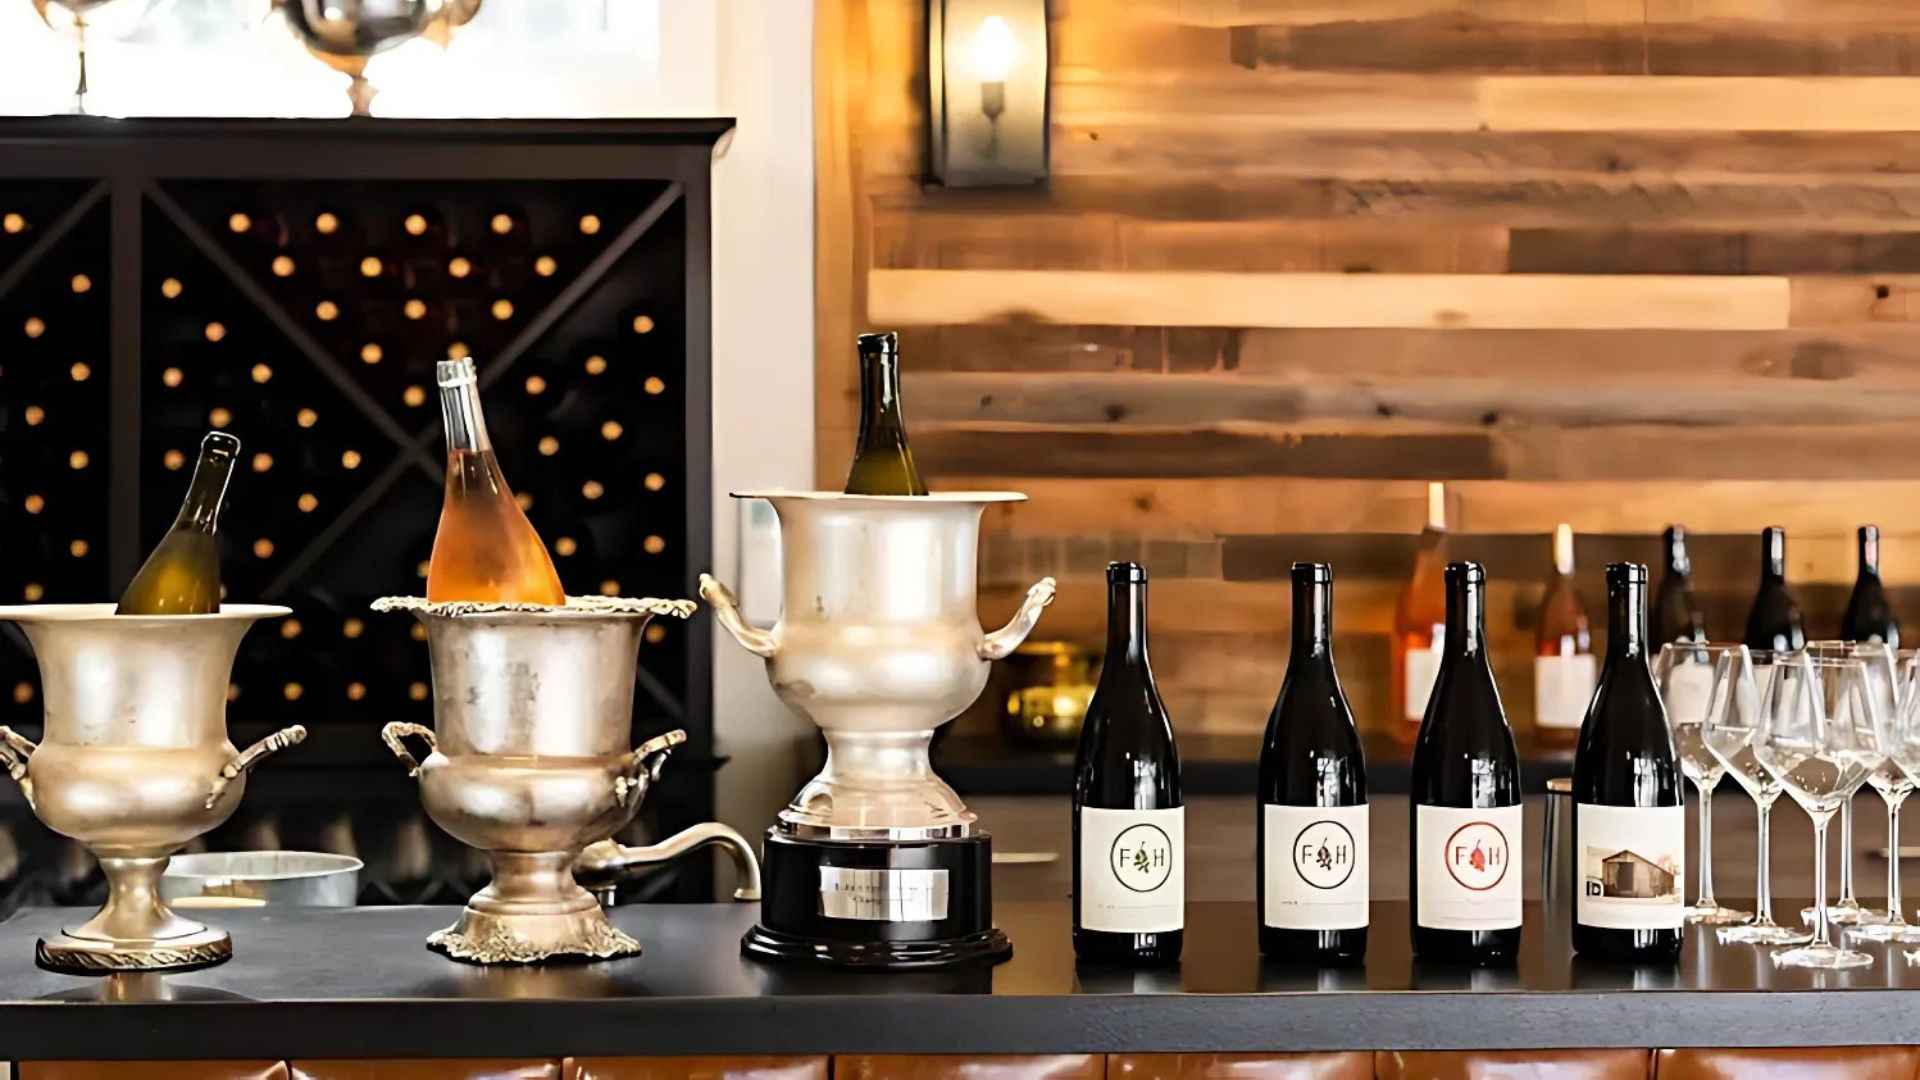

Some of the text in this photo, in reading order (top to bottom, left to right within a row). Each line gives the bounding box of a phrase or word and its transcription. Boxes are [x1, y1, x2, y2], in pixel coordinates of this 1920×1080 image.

[1119, 847, 1165, 868] F H
[1302, 844, 1347, 865] F H
[1455, 846, 1467, 866] F
